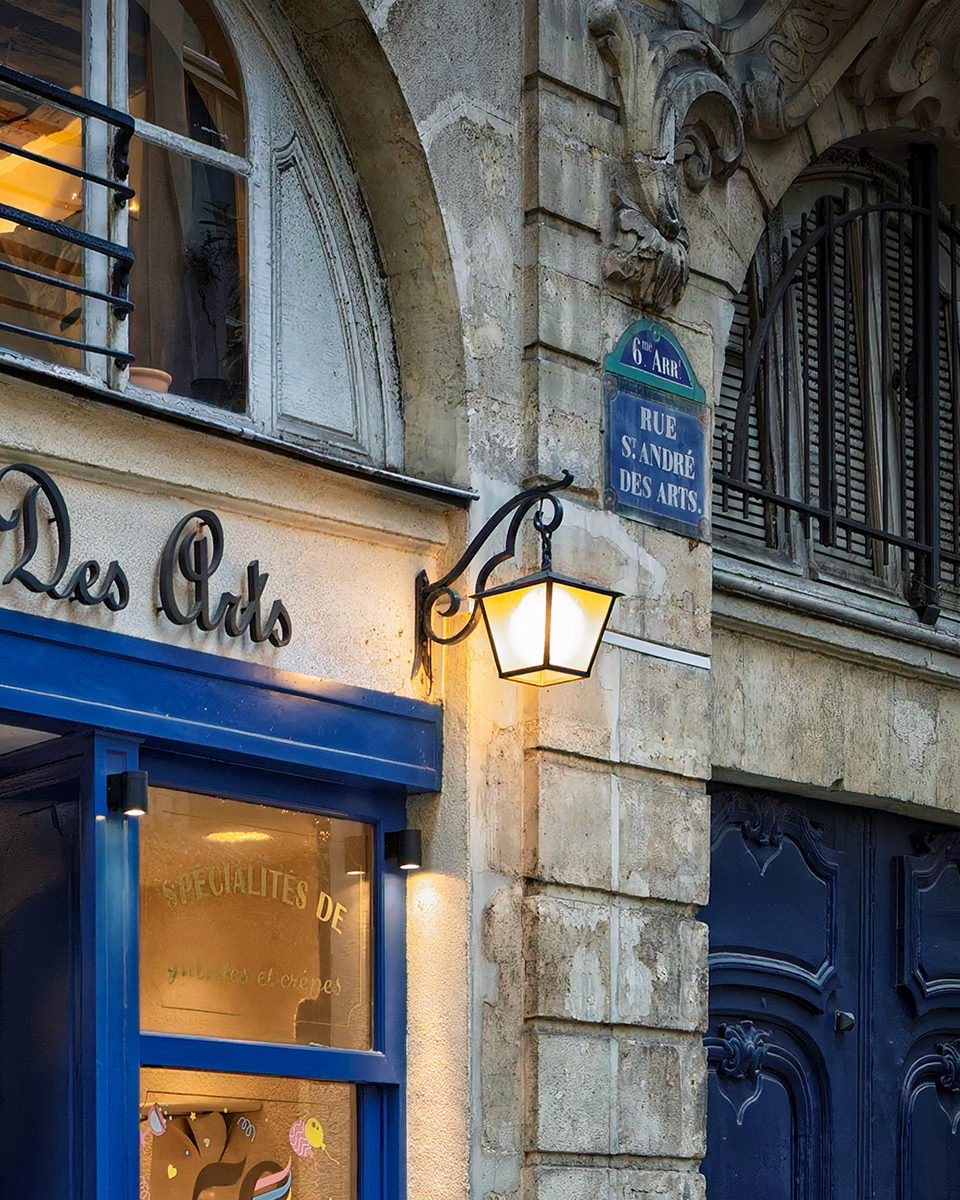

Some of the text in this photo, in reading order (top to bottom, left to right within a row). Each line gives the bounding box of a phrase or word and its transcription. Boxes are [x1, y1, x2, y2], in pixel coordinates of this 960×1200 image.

[640, 406, 677, 440] RUE
[639, 442, 695, 480] ANDRÉ
[619, 468, 652, 499] DES
[158, 508, 292, 648] Arts
[316, 891, 348, 935] DE
[257, 967, 273, 987] et
